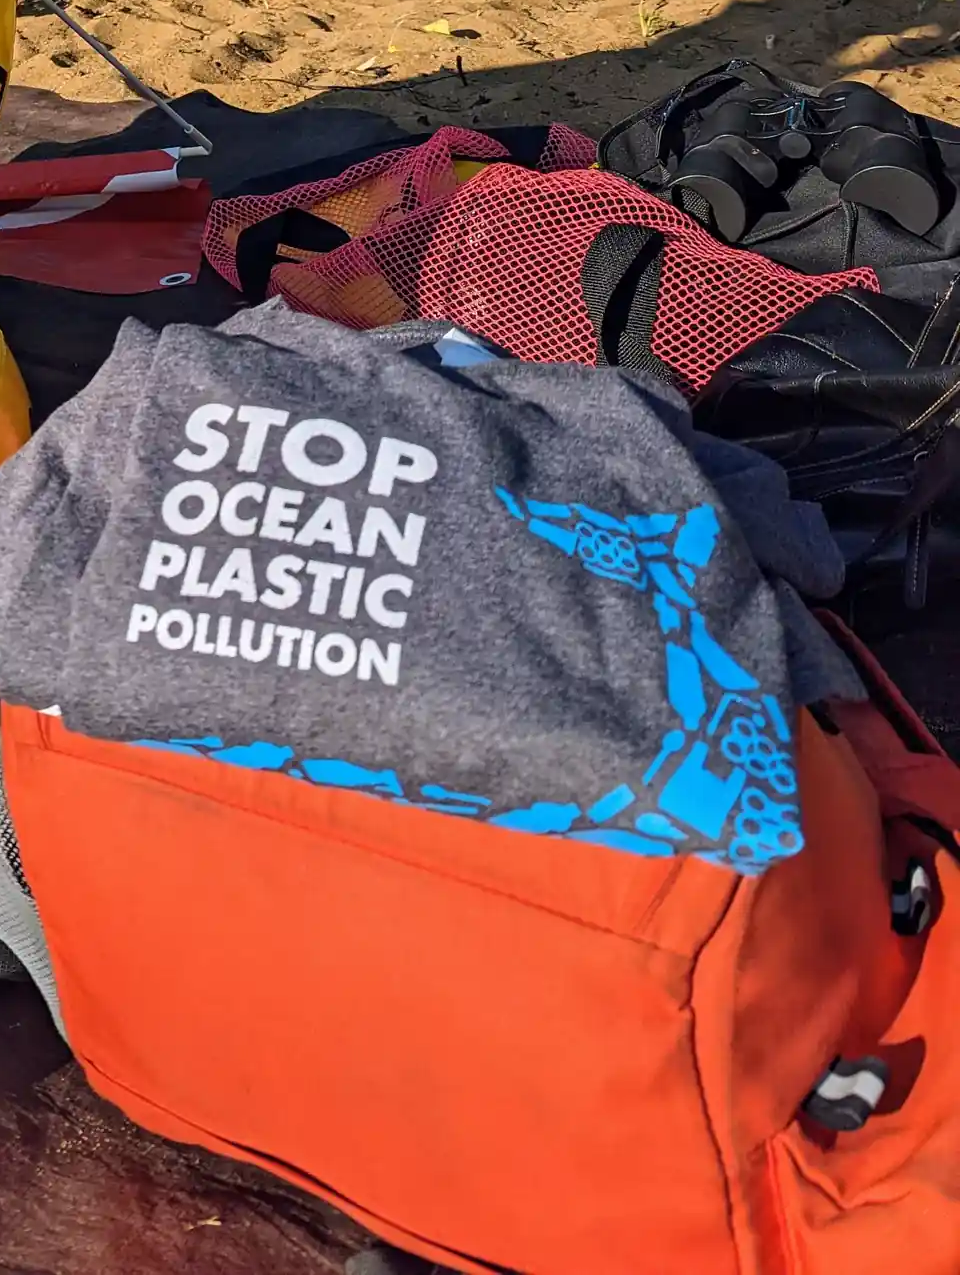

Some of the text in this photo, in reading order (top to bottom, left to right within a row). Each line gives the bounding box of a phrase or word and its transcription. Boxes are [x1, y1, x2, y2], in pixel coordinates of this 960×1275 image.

[172, 402, 438, 497] STOP
[161, 479, 427, 566] OCEAN
[138, 539, 414, 629] PLASTIC
[125, 602, 403, 686] POLLUTION
